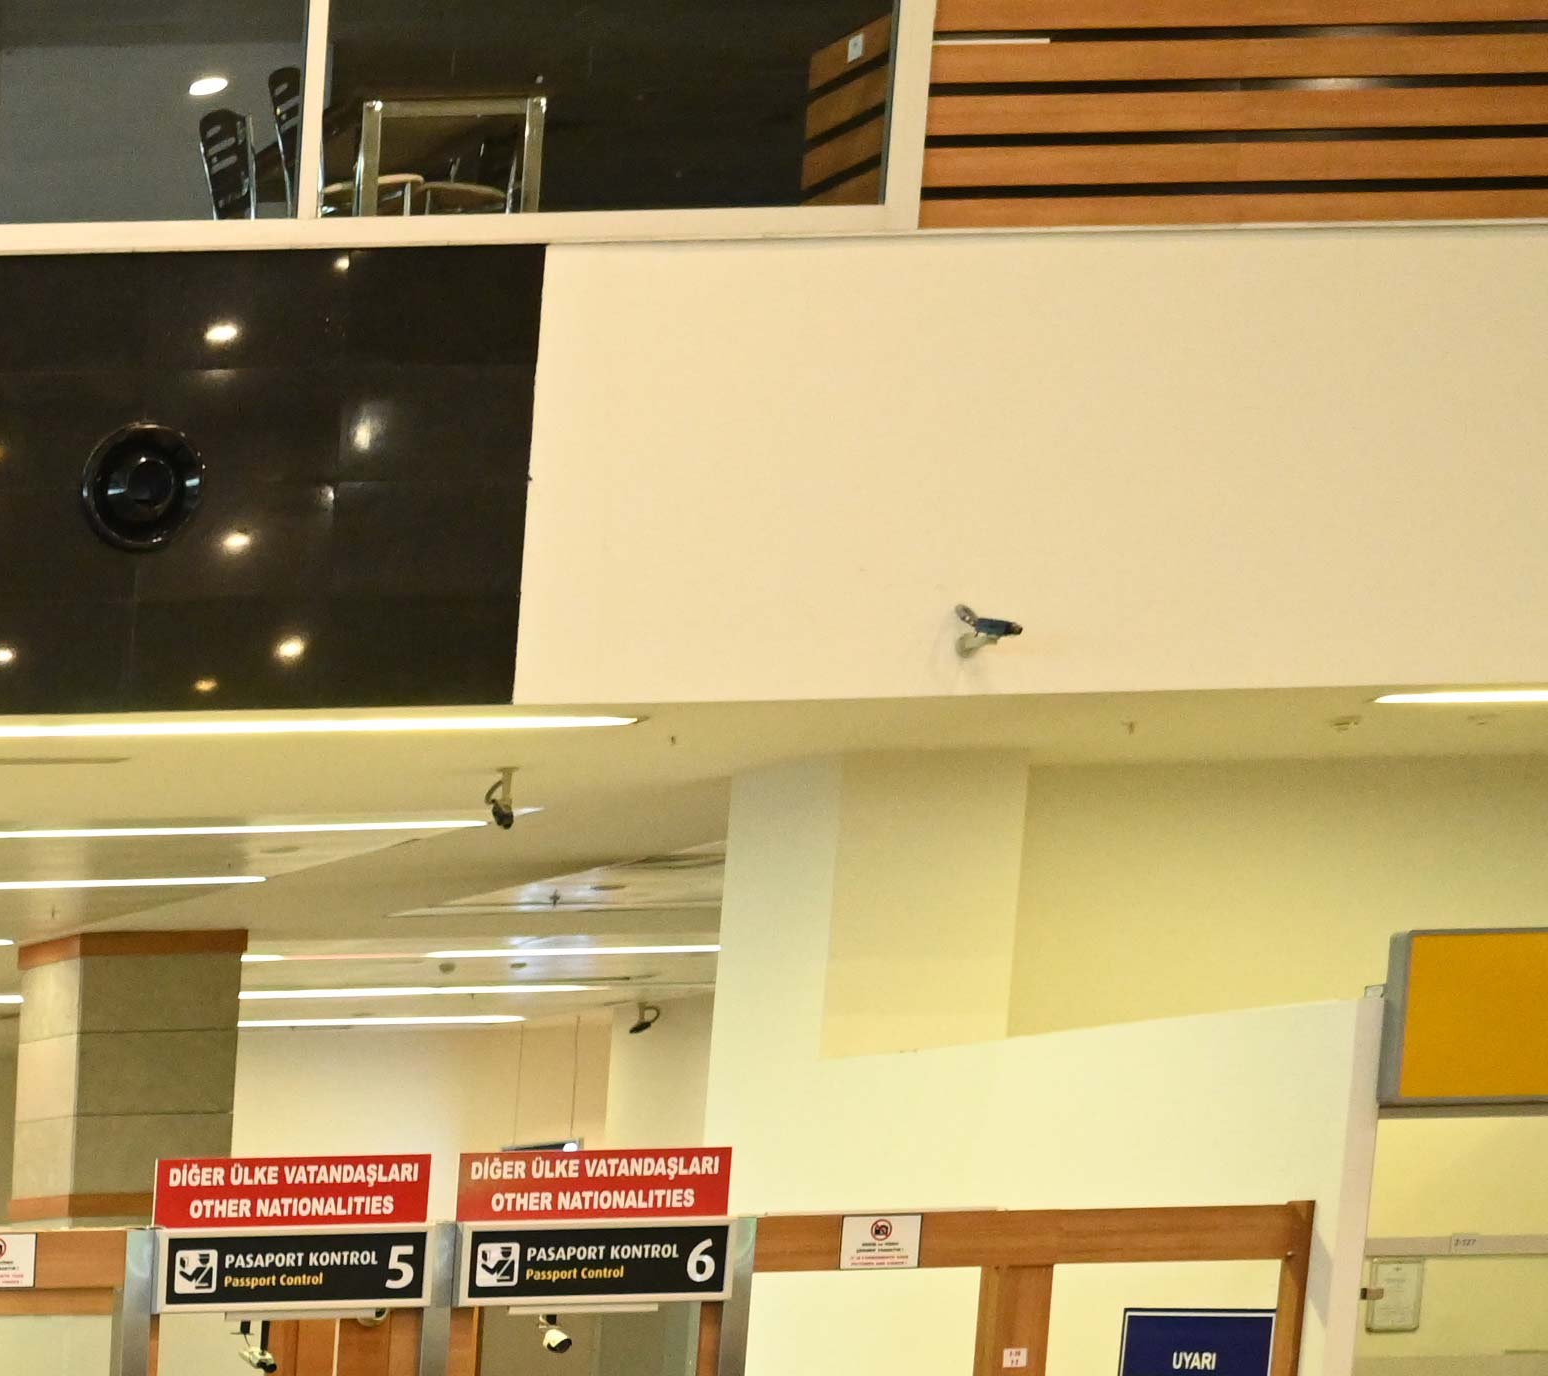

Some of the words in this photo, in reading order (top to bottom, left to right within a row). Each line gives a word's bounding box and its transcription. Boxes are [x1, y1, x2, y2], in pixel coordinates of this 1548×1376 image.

[169, 1164, 224, 1187] DİĞER
[230, 1164, 279, 1186] ÜLKE
[284, 1163, 419, 1187] VATANDAŞLARI
[471, 1158, 525, 1180] DİĞER
[531, 1157, 579, 1178] ÜLKE
[585, 1156, 719, 1180] VATANDAŞLARI
[189, 1199, 251, 1218] OTHER
[256, 1195, 394, 1217] NATIONALITIES
[491, 1192, 552, 1212] OTHER
[557, 1189, 694, 1210] NATIONALITIES
[225, 1253, 302, 1268] PASAPORT
[309, 1251, 378, 1266] KONTROL
[385, 1245, 414, 1289] 5
[527, 1246, 604, 1261] PASAPORT
[611, 1244, 679, 1259] KONTROL
[687, 1238, 715, 1282] 6
[224, 1274, 276, 1288] Passport
[280, 1272, 323, 1286] Control
[526, 1268, 577, 1282] Passport
[581, 1266, 624, 1278] Control
[1173, 1352, 1216, 1369] UYARI
